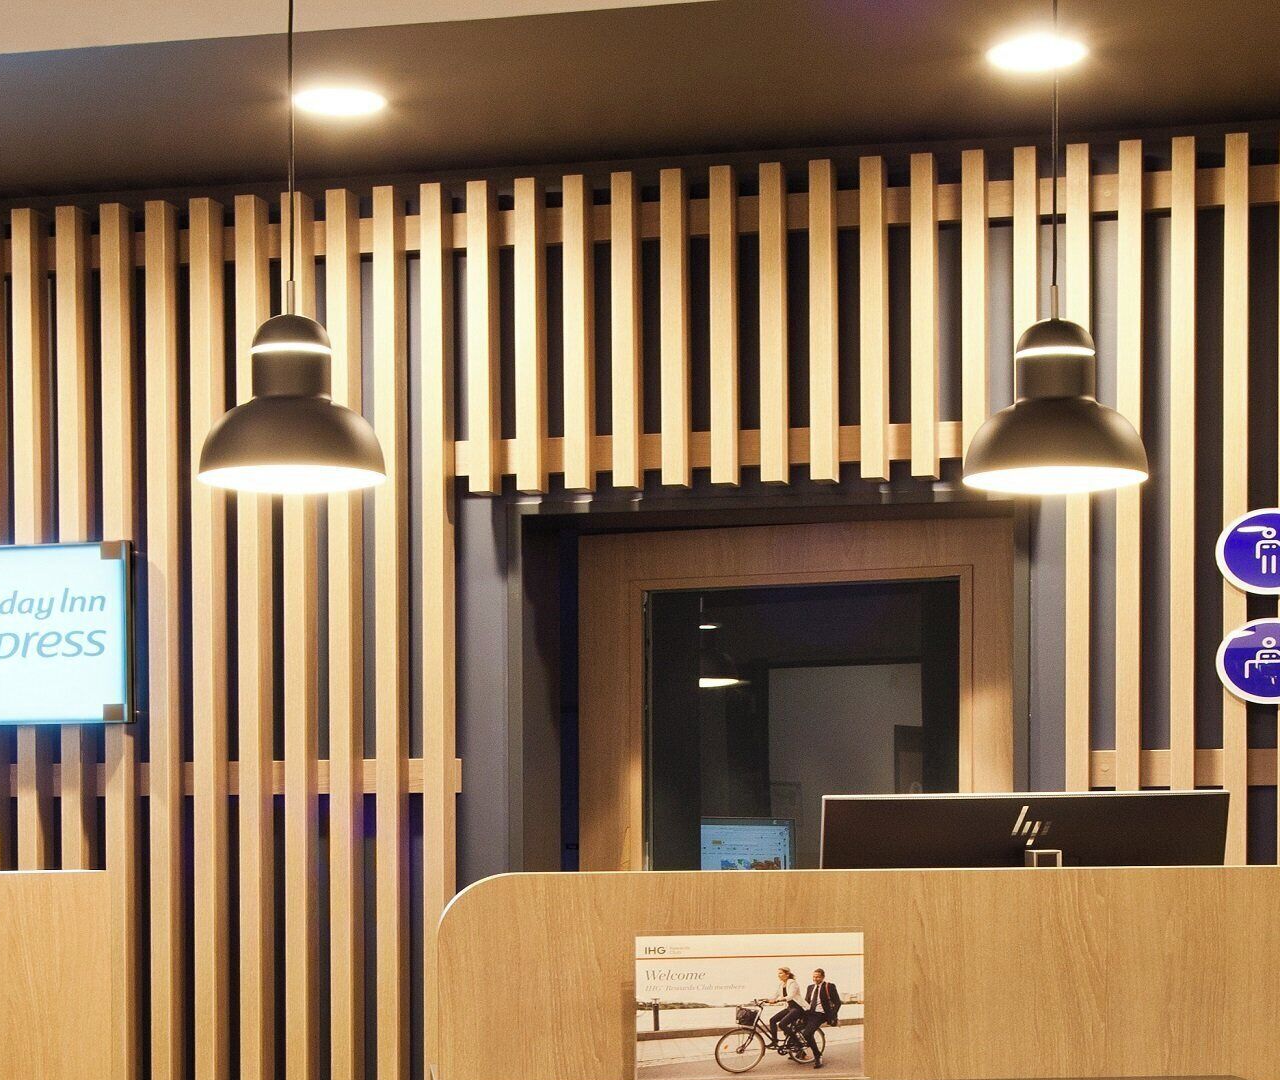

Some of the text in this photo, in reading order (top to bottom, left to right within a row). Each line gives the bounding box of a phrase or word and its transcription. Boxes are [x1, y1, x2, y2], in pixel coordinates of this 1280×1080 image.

[60, 587, 107, 613] Inn
[644, 946, 667, 955] IHG
[645, 969, 706, 981] Welcome
